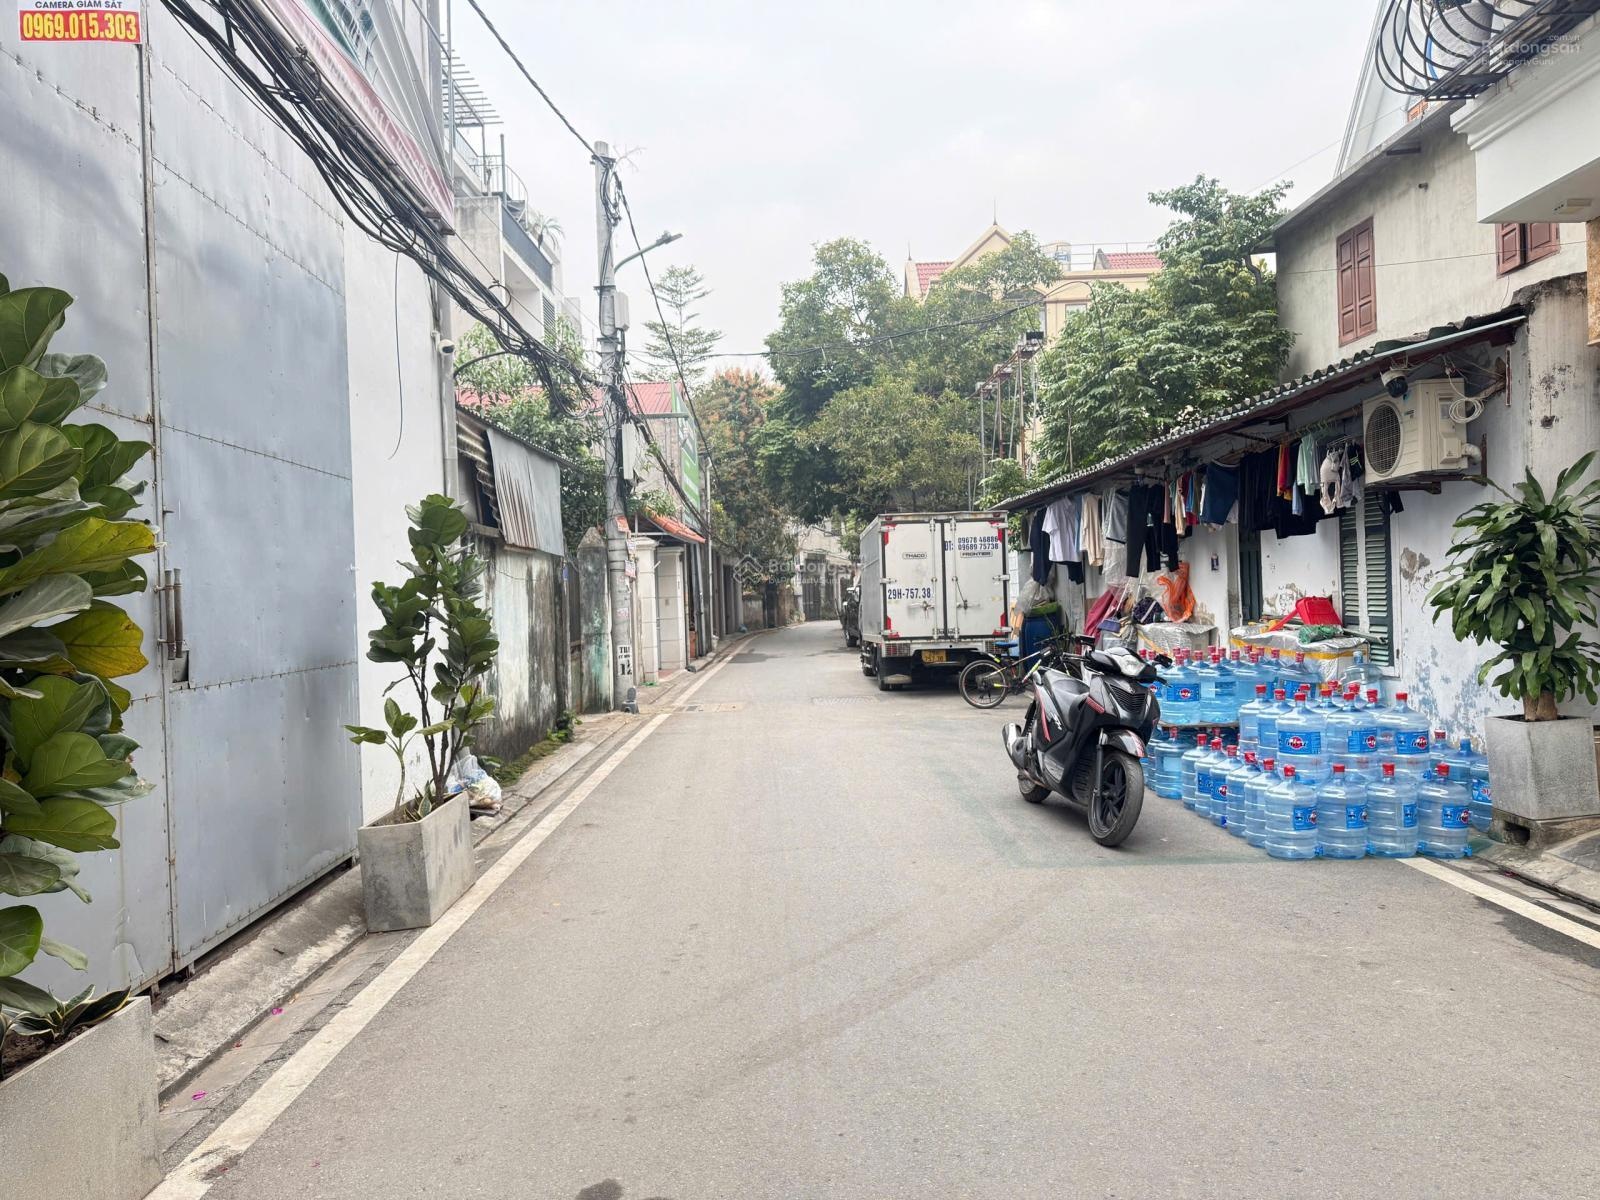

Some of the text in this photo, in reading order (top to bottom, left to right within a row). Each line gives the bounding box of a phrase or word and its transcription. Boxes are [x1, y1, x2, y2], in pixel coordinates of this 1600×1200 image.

[34, 1, 74, 9] CAMERA
[22, 12, 137, 40] 0969.015.303
[887, 587, 931, 600] 29H-757.38
